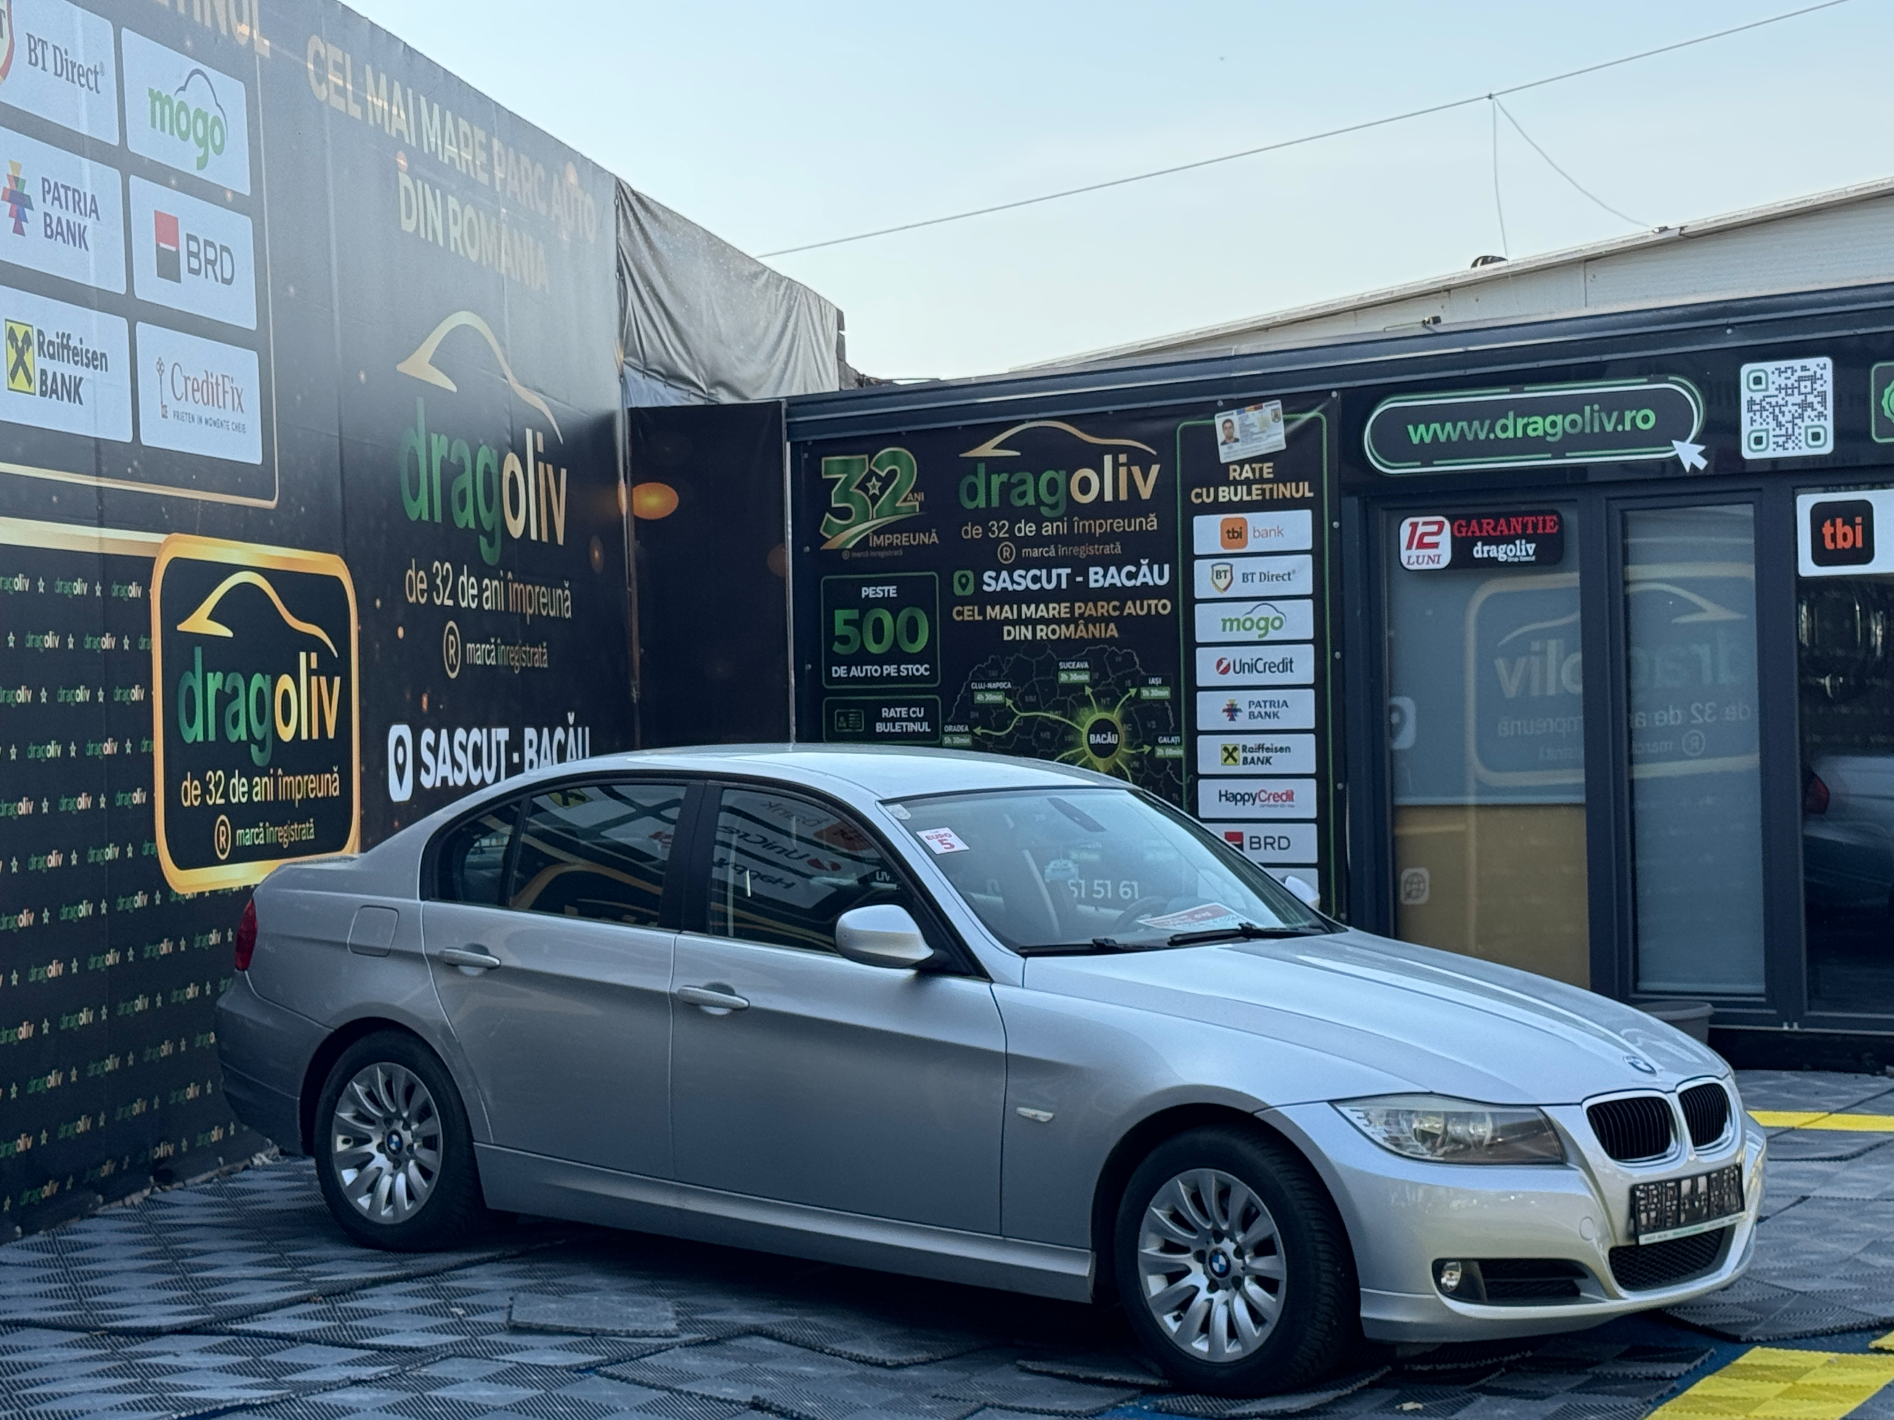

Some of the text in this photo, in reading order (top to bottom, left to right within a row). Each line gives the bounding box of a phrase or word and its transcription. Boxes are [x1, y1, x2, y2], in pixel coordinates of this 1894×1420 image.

[26, 33, 49, 72] BT
[148, 87, 226, 170] mogo
[307, 34, 362, 120] CEL
[365, 64, 416, 148] MAI
[419, 94, 489, 186] MARE
[492, 137, 547, 216] PARC
[41, 177, 100, 221] PATRIA
[398, 170, 444, 248] DIN
[43, 212, 89, 252] BANK
[186, 233, 235, 286] BRD
[37, 328, 108, 373] Raiffeisen
[39, 369, 84, 406] BANK
[170, 363, 245, 414] CreditFix
[1407, 404, 1656, 445] www.dragoliv.ro
[401, 397, 567, 566] dragoliv
[1229, 462, 1274, 480] RATE
[820, 447, 925, 539] 32 ANI
[959, 454, 1161, 518] dragoliv
[1191, 482, 1314, 504] CU BULETINUL
[868, 528, 939, 547] ÎMPREUNĂ
[961, 512, 1158, 539] de 32 de ani împreună
[1226, 525, 1284, 540] tbi bank
[1405, 521, 1445, 551] 12
[1453, 515, 1559, 538] GARANTIE
[1822, 516, 1863, 550] tbi
[1022, 543, 1056, 558] marcă
[1058, 542, 1122, 558] înregistrată
[1406, 553, 1442, 566] LUNI
[1473, 539, 1536, 562] dragoliv
[982, 568, 1071, 592] SASCUT
[1088, 558, 1170, 589] BACĂU
[1215, 569, 1229, 580] BT
[1241, 572, 1257, 583] BT
[0, 573, 143, 601] ragoliv dragoliv dragoliv
[405, 558, 572, 625] de 32 de ani împreună
[861, 586, 898, 598] PESTE
[952, 599, 1172, 621] CEL MAI MARE PARC AUTO
[832, 606, 929, 655] 500
[1003, 620, 1118, 641] DIN ROMÂNIA
[1221, 616, 1284, 639] mogo
[25, 630, 60, 653] dragoliv
[83, 632, 116, 653] dragoliv
[466, 637, 496, 666] marcă
[497, 639, 549, 674] înregistrată
[1059, 661, 1089, 670] SUCEAVA
[1233, 657, 1295, 675] UniCredit
[831, 664, 930, 677] DE AUTO PE STOC
[57, 685, 91, 706] dragoliv
[113, 684, 145, 705] dragoliv
[971, 681, 1012, 690] CLUJ-NAPOCA
[178, 646, 341, 767] dragoliv
[881, 707, 924, 718] RATE CU
[1248, 700, 1289, 709] PATRIA
[1248, 710, 1280, 720] BANK
[875, 722, 931, 733] BULETINUL
[944, 724, 969, 733] ORADEA
[1089, 731, 1118, 744] BACĂU
[27, 740, 62, 763] dragoliv
[86, 737, 119, 761] dragoliv
[420, 727, 509, 789] SASCUT
[524, 712, 590, 774] BACĂU
[1241, 743, 1291, 754] Raiffeisen
[1241, 756, 1273, 766] BANK
[181, 765, 340, 808] de 32 de ani împreună
[1218, 789, 1295, 806] HappyCredit
[59, 792, 93, 814] dragoliv
[115, 787, 147, 809] dragoliv
[236, 822, 265, 847] marcă
[938, 839, 955, 850] 5
[1249, 836, 1291, 850] BRD
[28, 850, 63, 873] dragoliv
[87, 843, 120, 865] dragoliv
[1092, 879, 1112, 899] 51
[1119, 880, 1139, 900] 61
[59, 900, 93, 922] dragoliv
[116, 891, 149, 913] dragoliv
[28, 960, 64, 983] dragoliv
[88, 948, 121, 970] dragoliv
[59, 1007, 94, 1030] dragoliv
[27, 1069, 63, 1094] dragoliv
[58, 1114, 92, 1139] dragoliv
